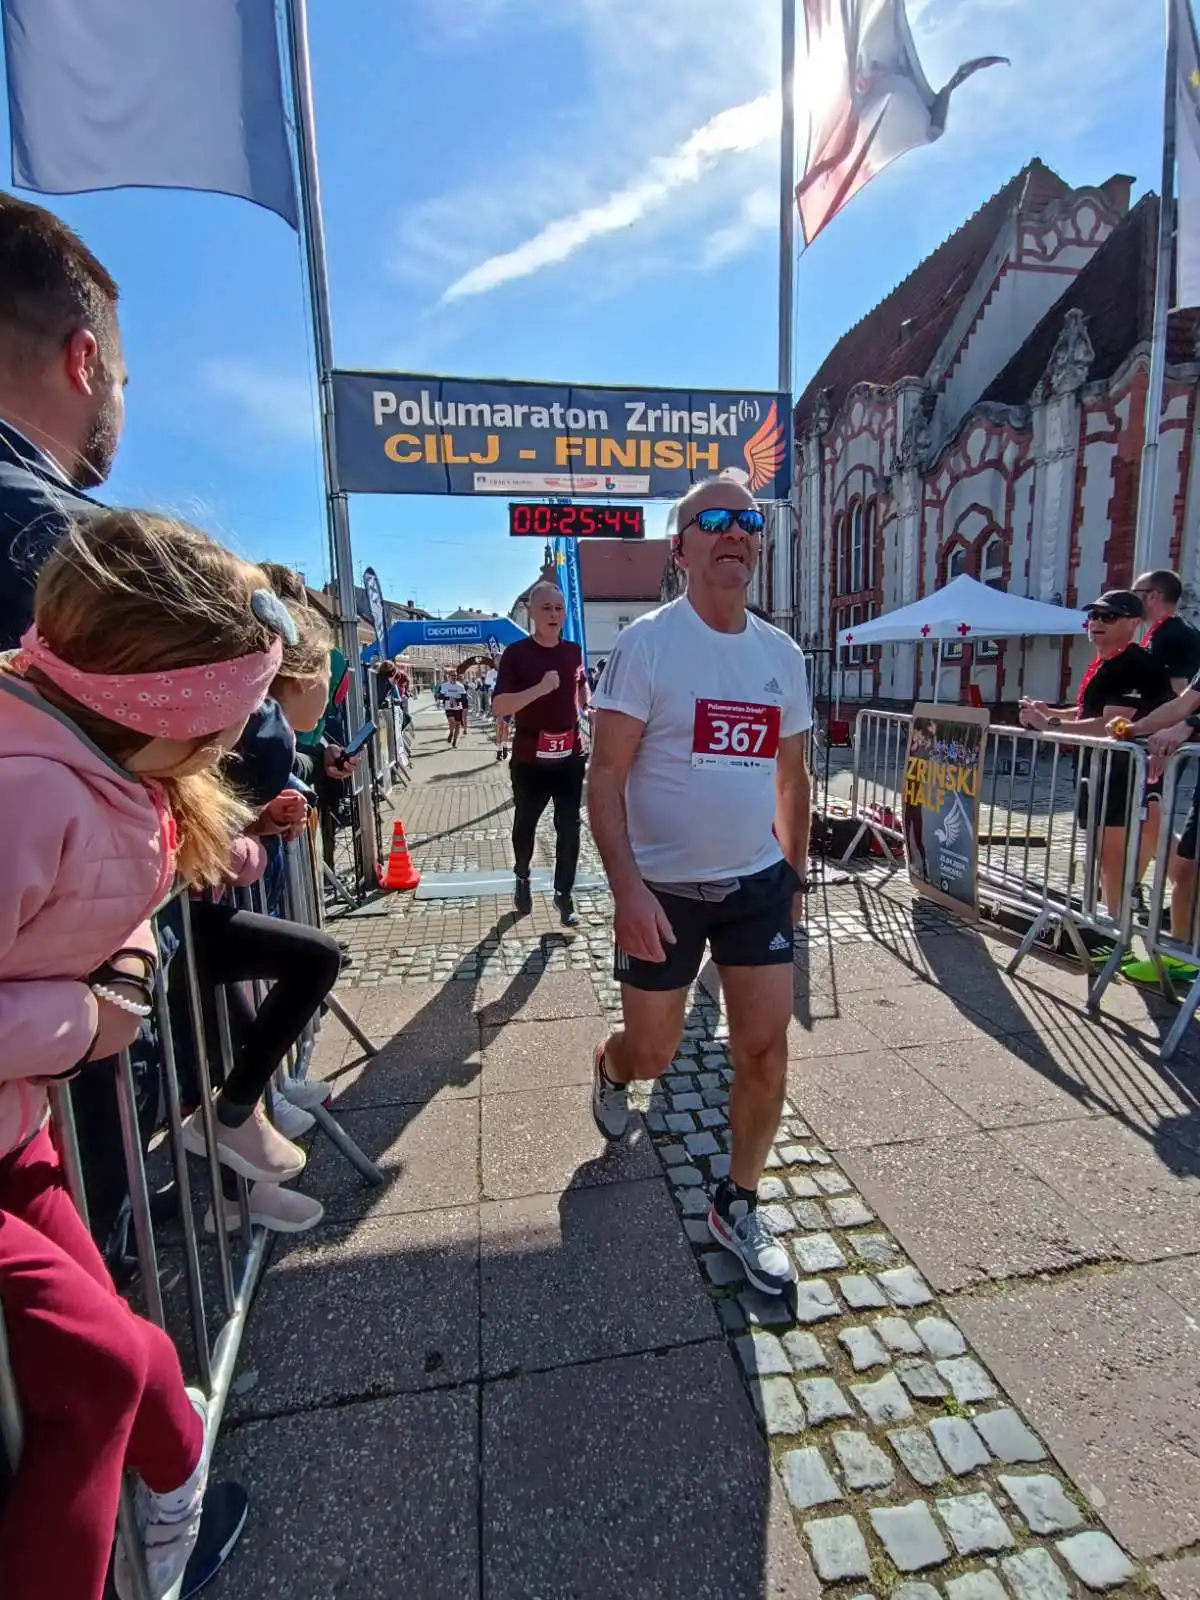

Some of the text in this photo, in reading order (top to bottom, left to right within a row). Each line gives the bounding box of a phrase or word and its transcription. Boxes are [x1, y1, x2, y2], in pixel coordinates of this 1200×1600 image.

[373, 390, 609, 430] Polumaraton
[384, 433, 500, 464] CILJ
[555, 436, 719, 470] FINISH
[513, 506, 641, 534] 00:25:44
[427, 625, 477, 638] DECATHLON
[548, 740, 565, 752] 31
[708, 720, 768, 753] 367
[906, 756, 976, 797] ZRINSKI
[904, 780, 945, 813] HALF
